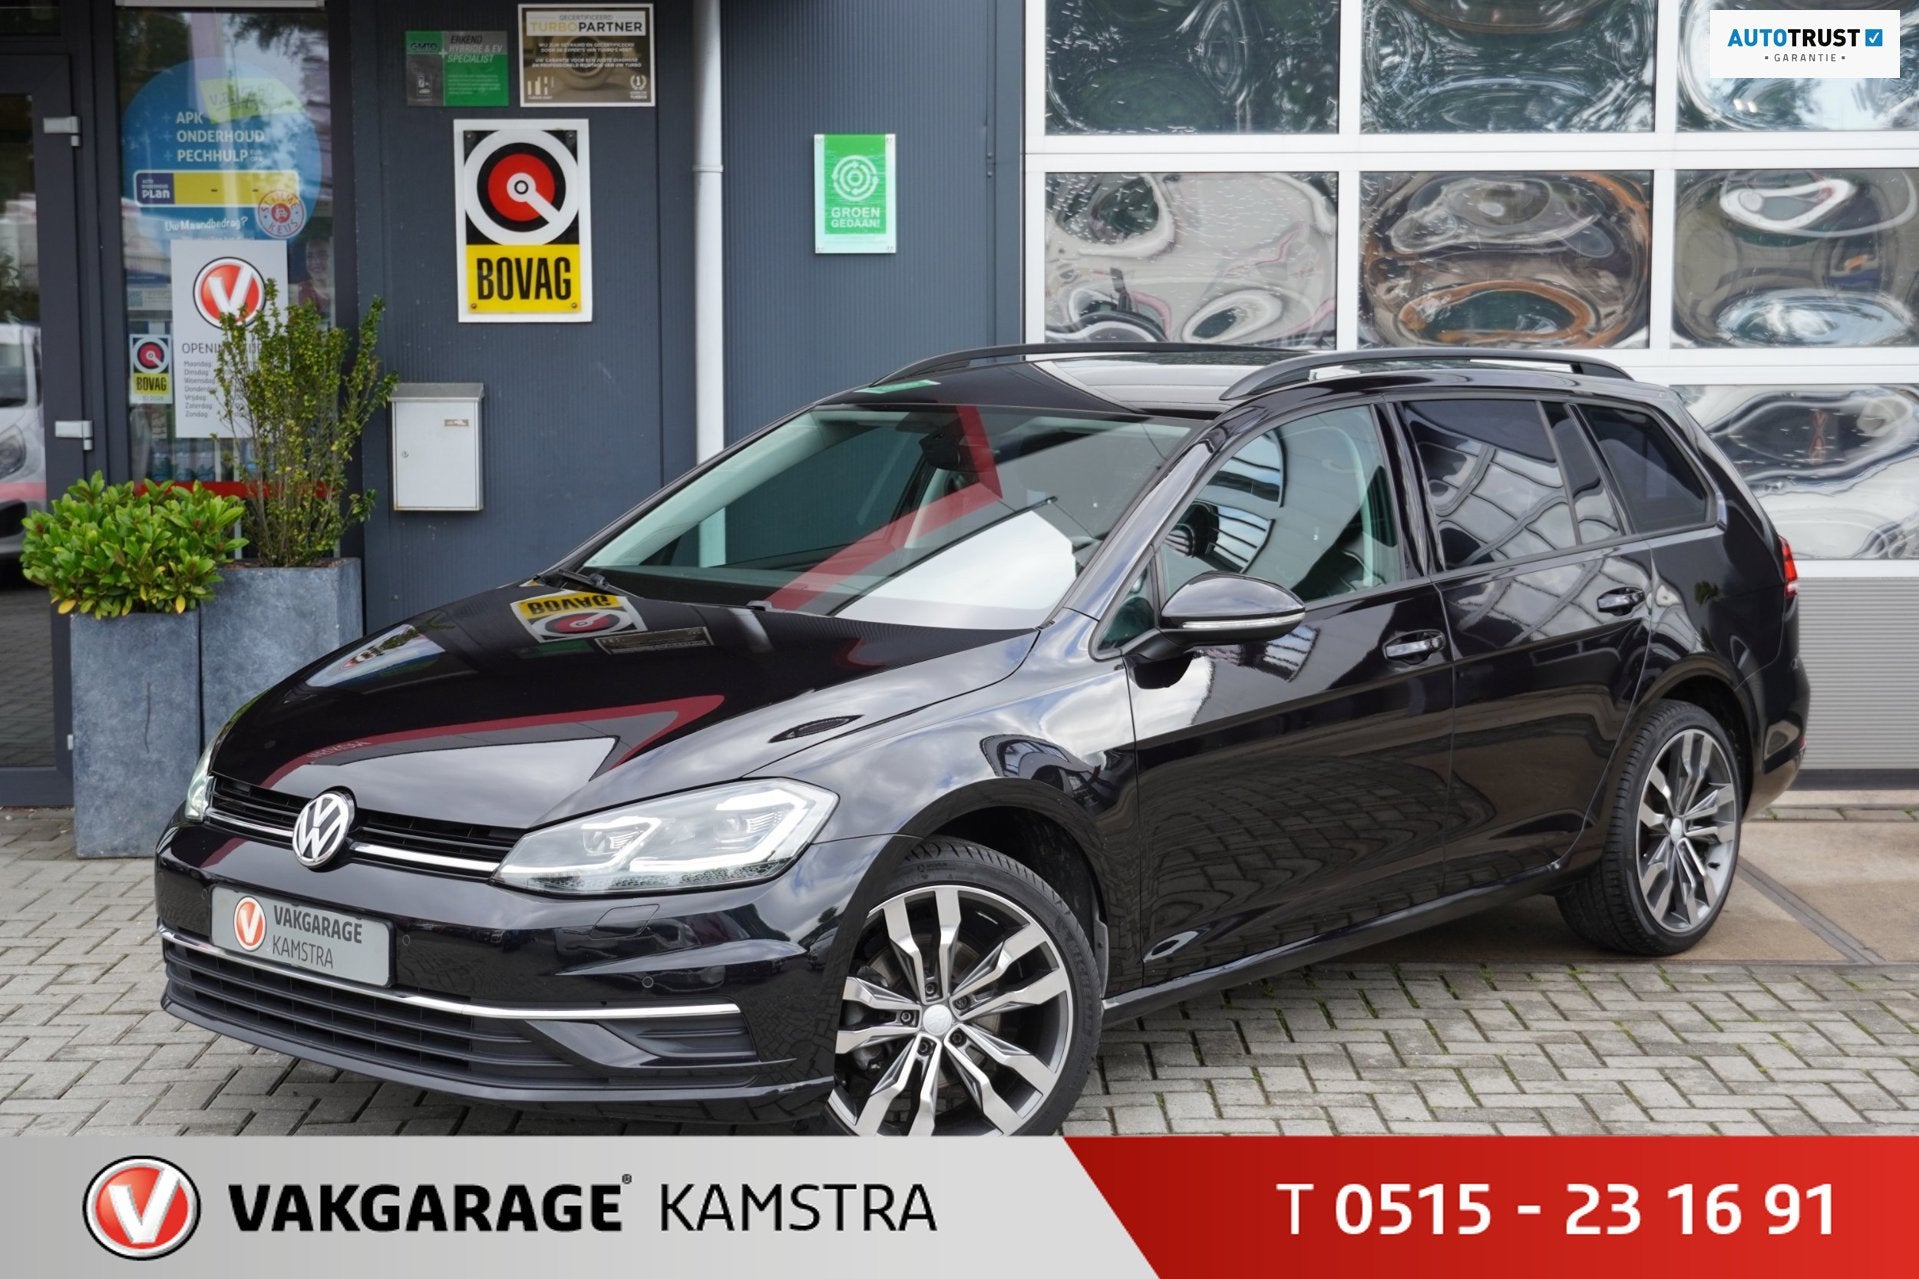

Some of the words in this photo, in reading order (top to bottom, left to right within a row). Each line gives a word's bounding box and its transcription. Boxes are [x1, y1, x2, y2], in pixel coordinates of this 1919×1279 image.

[531, 21, 642, 32] TURBOPARTNER
[450, 35, 483, 44] ERKEND
[447, 54, 494, 63] SPECIALIST
[176, 111, 204, 125] APK
[176, 130, 265, 143] ONDERHOUD
[177, 149, 248, 162] PECHHULP
[831, 207, 880, 218] GROEN
[831, 219, 880, 228] GEDAAN!
[476, 256, 572, 301] BOVAG
[136, 376, 167, 392] BOVAG
[273, 904, 363, 944] VAKGARAGE
[272, 935, 334, 969] KAMSTRA
